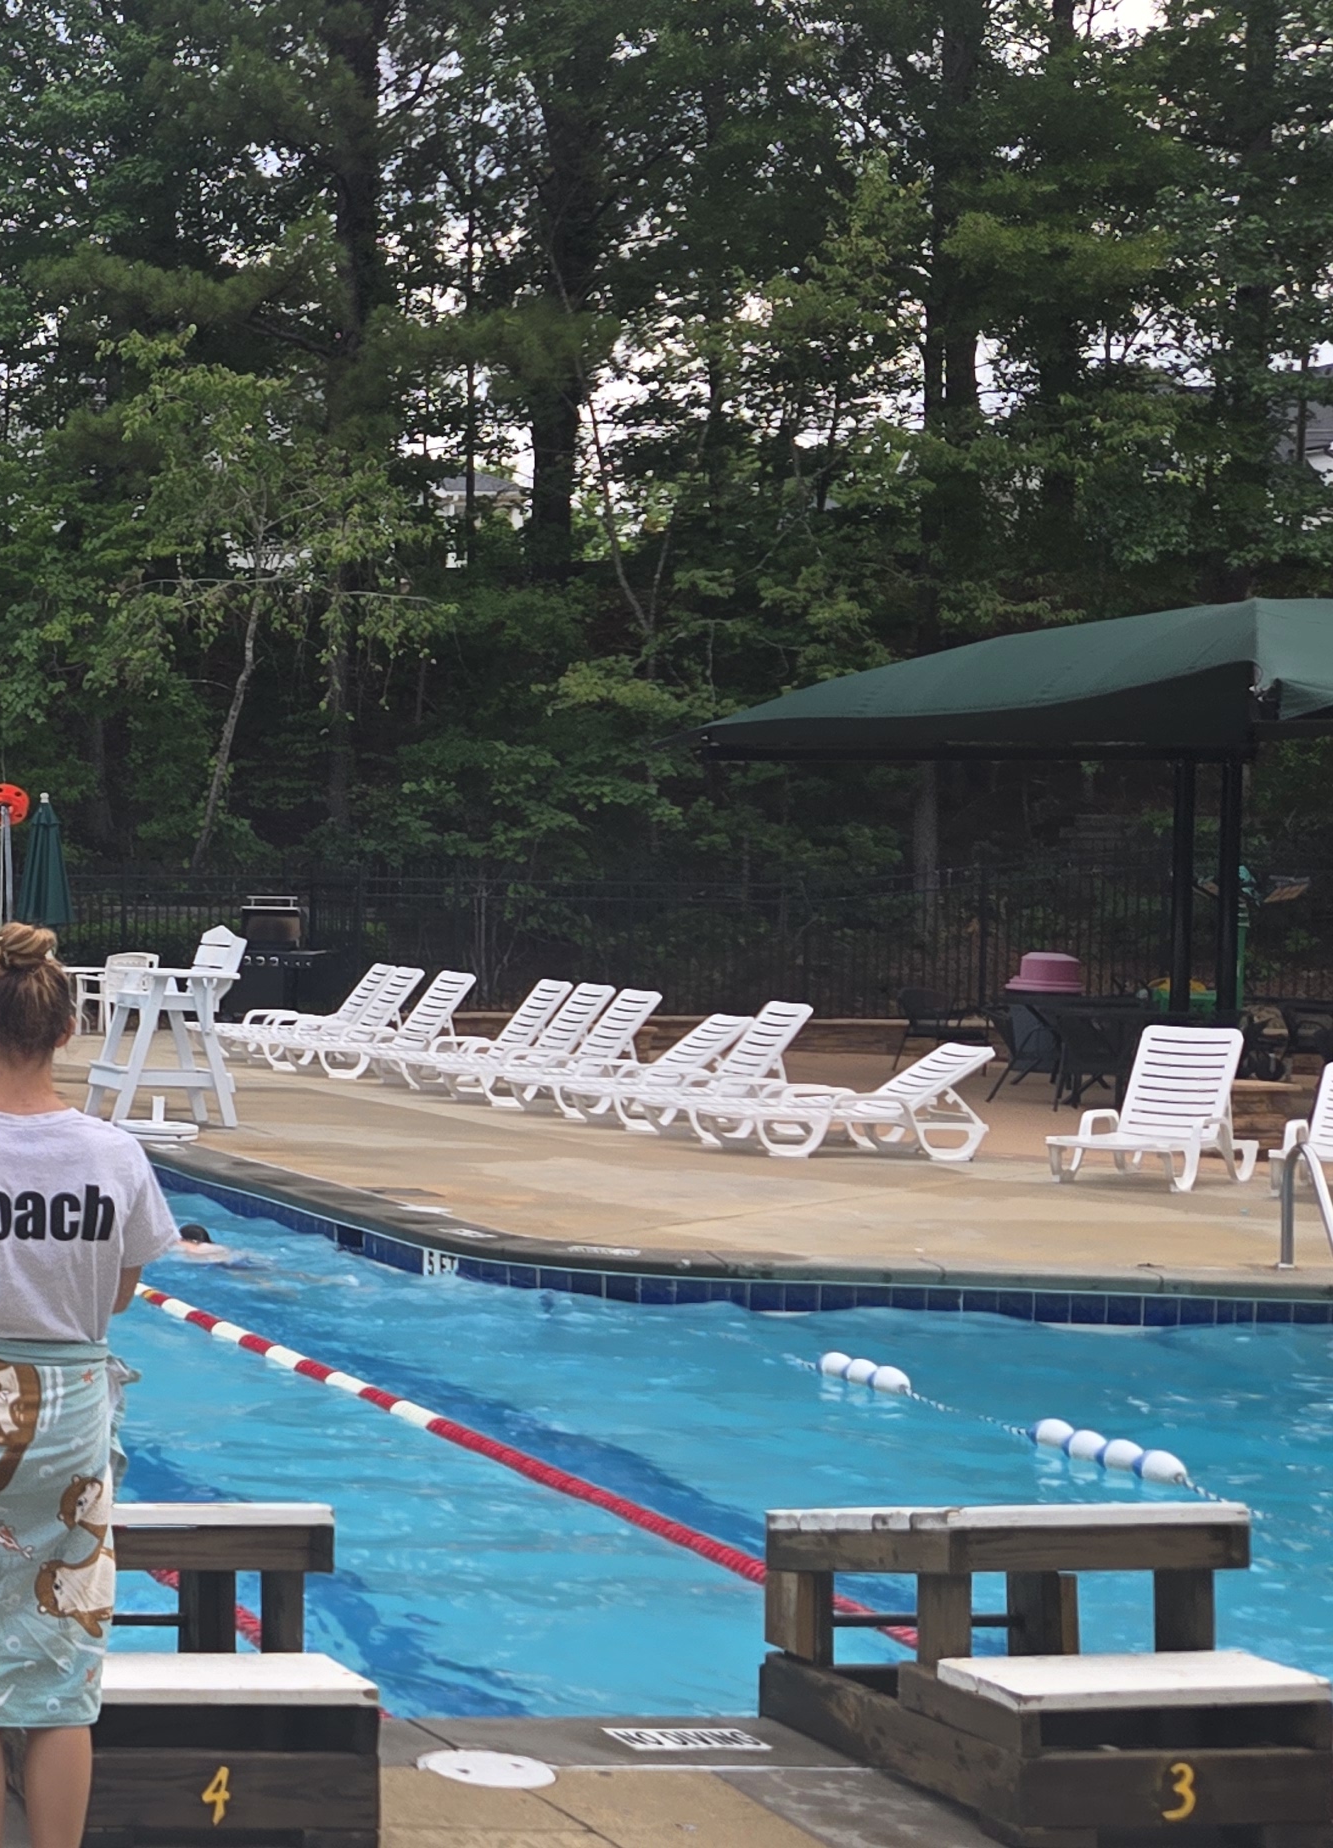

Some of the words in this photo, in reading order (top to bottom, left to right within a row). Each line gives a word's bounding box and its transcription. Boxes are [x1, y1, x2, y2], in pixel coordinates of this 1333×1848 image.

[428, 1250, 434, 1276] 5
[440, 1253, 457, 1273] FT
[612, 1731, 664, 1746] NO
[656, 1731, 761, 1746] DIVING
[201, 1766, 230, 1826] 4
[1162, 1762, 1196, 1820] 3
